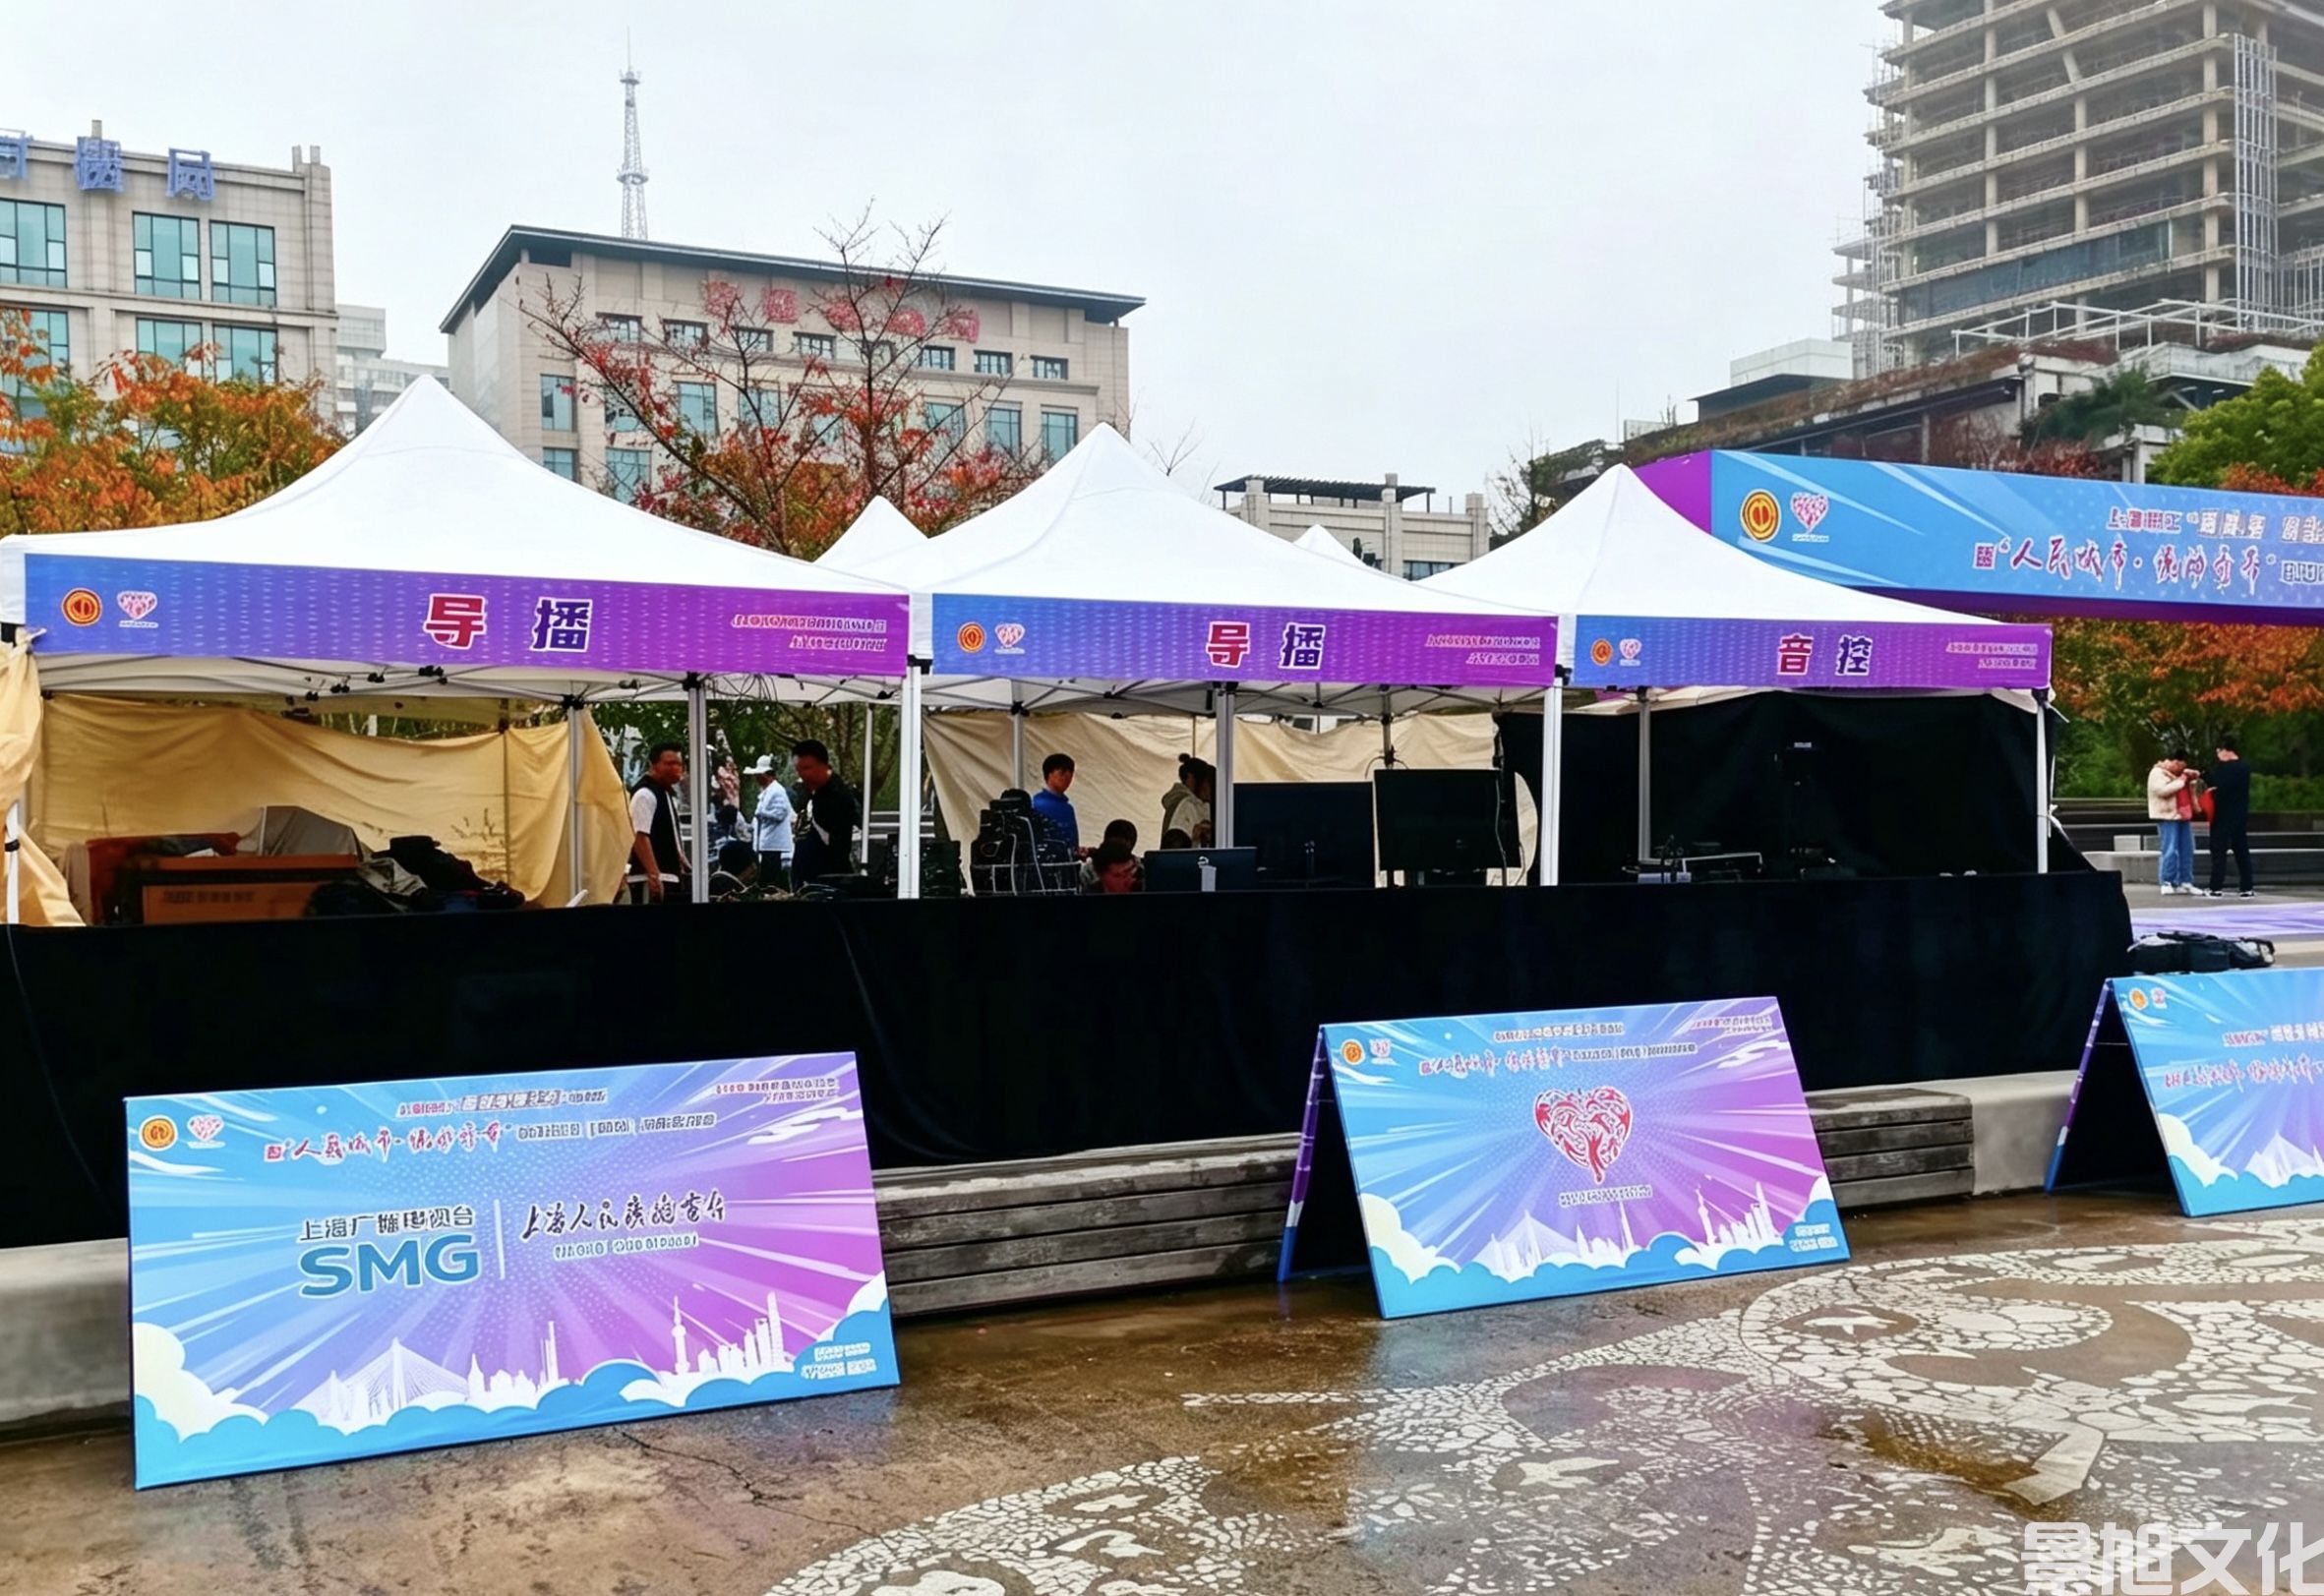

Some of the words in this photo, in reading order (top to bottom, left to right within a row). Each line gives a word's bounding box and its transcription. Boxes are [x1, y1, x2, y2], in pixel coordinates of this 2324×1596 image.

[425, 594, 591, 651] 导播
[1206, 621, 1326, 669] 导播
[1776, 633, 1873, 676] 音控
[299, 1234, 479, 1297] SMG
